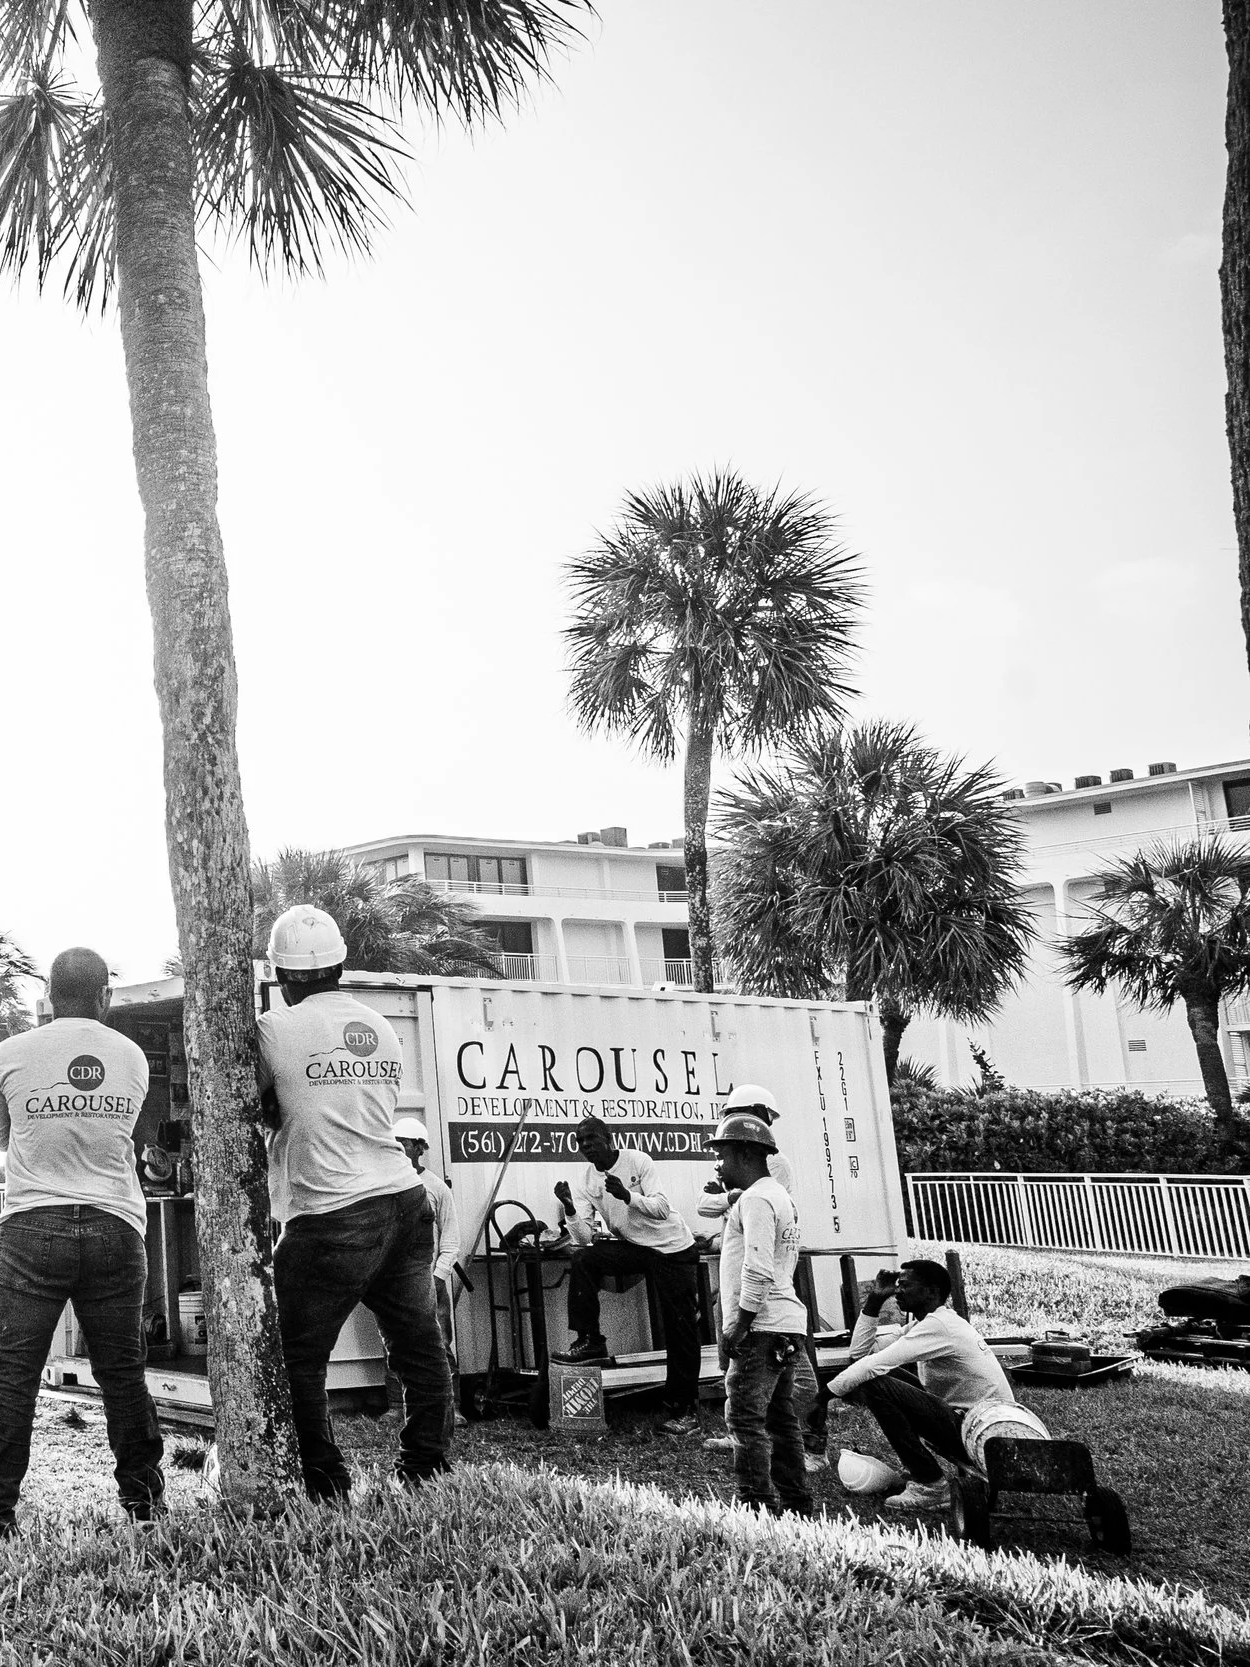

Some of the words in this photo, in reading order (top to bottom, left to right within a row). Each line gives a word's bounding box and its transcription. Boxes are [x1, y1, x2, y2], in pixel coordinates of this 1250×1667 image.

[345, 1032, 377, 1046] CDR
[69, 1066, 103, 1080] CDR
[456, 1040, 734, 1096] CAROUSEL
[837, 1051, 848, 1111] 22G1
[25, 1095, 135, 1115] CAROUSEL
[581, 1099, 597, 1118] &
[601, 1099, 704, 1121] RESTORATION,
[461, 1130, 506, 1159] (561)
[512, 1131, 580, 1153] 272-370
